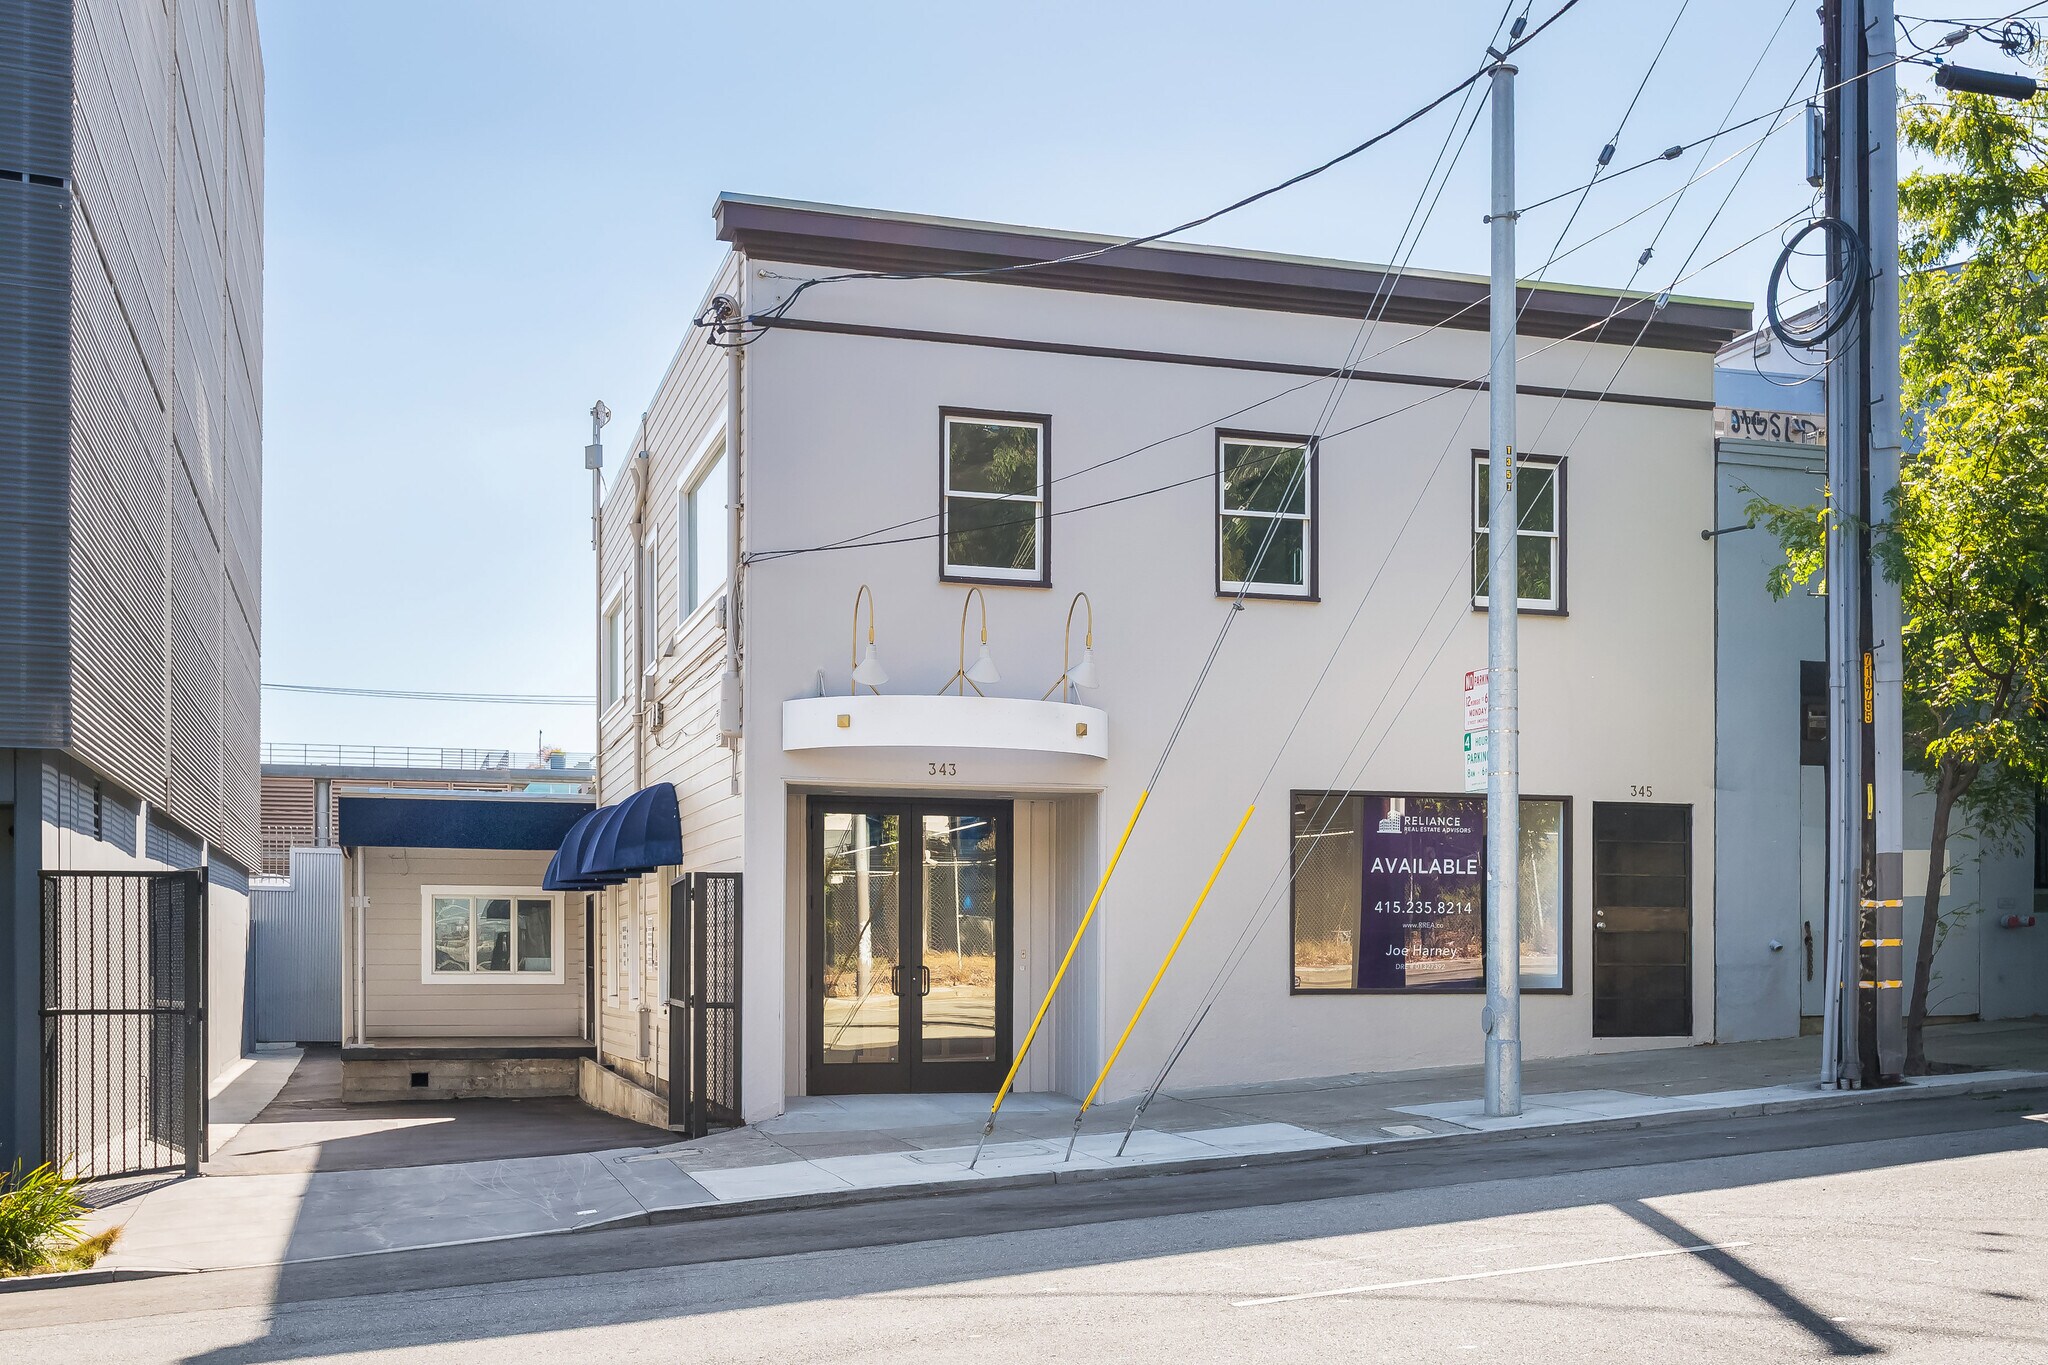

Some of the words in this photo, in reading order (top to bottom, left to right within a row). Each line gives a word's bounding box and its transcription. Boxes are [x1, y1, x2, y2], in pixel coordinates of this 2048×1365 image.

[1465, 674, 1474, 690] NO
[1864, 654, 1872, 722] 714755
[1468, 706, 1487, 717] MONDAY
[1465, 736, 1470, 749] 4
[1467, 751, 1488, 764] PARKIN
[928, 762, 957, 776] 343
[1630, 785, 1653, 798] 345
[1404, 816, 1461, 827] RELIANCE
[1370, 857, 1478, 875] AVAILABLE
[1374, 900, 1472, 914] 415.235.8214
[1402, 921, 1444, 929] www.RREA.co
[1385, 944, 1409, 956] Joe
[1413, 944, 1457, 959] Harney
